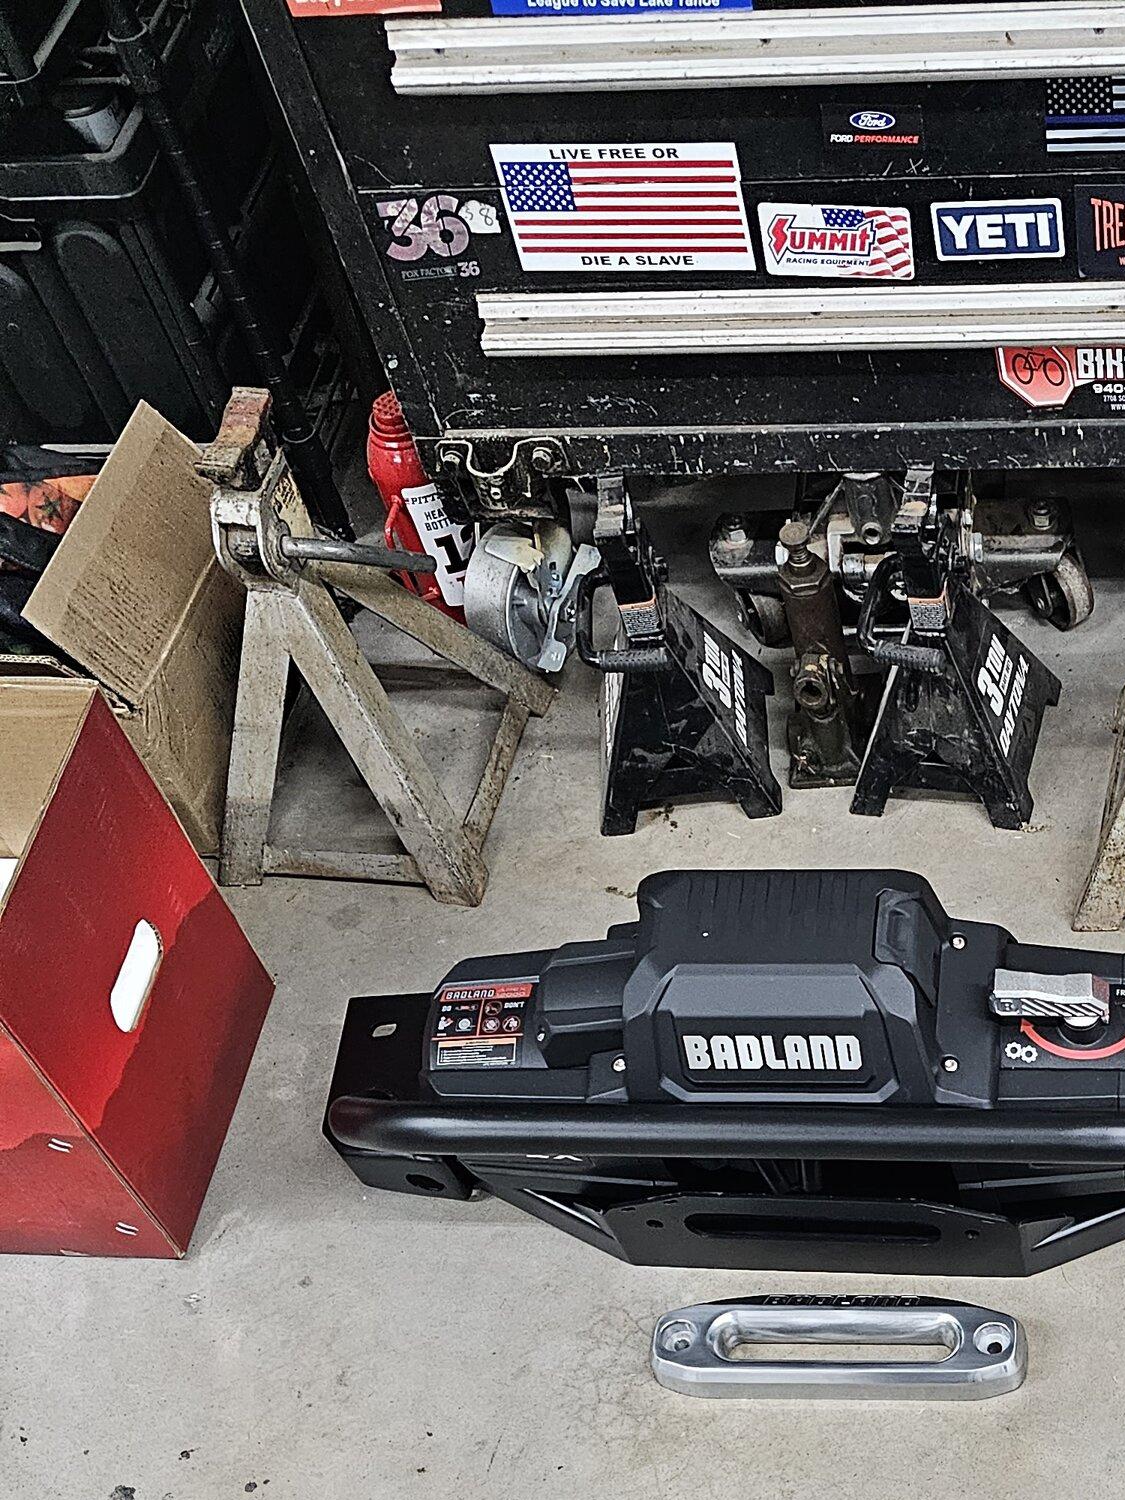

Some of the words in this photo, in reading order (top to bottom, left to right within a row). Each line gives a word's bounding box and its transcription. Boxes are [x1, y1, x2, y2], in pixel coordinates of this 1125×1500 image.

[858, 113, 887, 127] Ford
[830, 134, 853, 143] FORD
[854, 134, 919, 144] PERFORMANCE
[549, 148, 592, 160] LIVE
[599, 148, 646, 159] FREE
[653, 148, 679, 159] OR
[376, 194, 470, 262] 36
[940, 212, 1051, 250] YETI
[457, 261, 480, 277] 36
[581, 256, 612, 266] DIE
[618, 256, 630, 265] A
[635, 255, 695, 266] SLAVE
[786, 257, 818, 265] RACING
[820, 258, 870, 266] EQUIPMENT
[411, 493, 440, 505] PITT
[424, 508, 445, 521] HEA
[704, 631, 721, 678] TON
[985, 633, 1006, 682] TON
[703, 662, 732, 709] 3
[731, 648, 747, 747] DAYTONA
[977, 666, 1004, 717] 3
[1000, 654, 1030, 758] DAYTONA
[445, 989, 495, 1000] BADLAND
[682, 1035, 863, 1070] BADLAND
